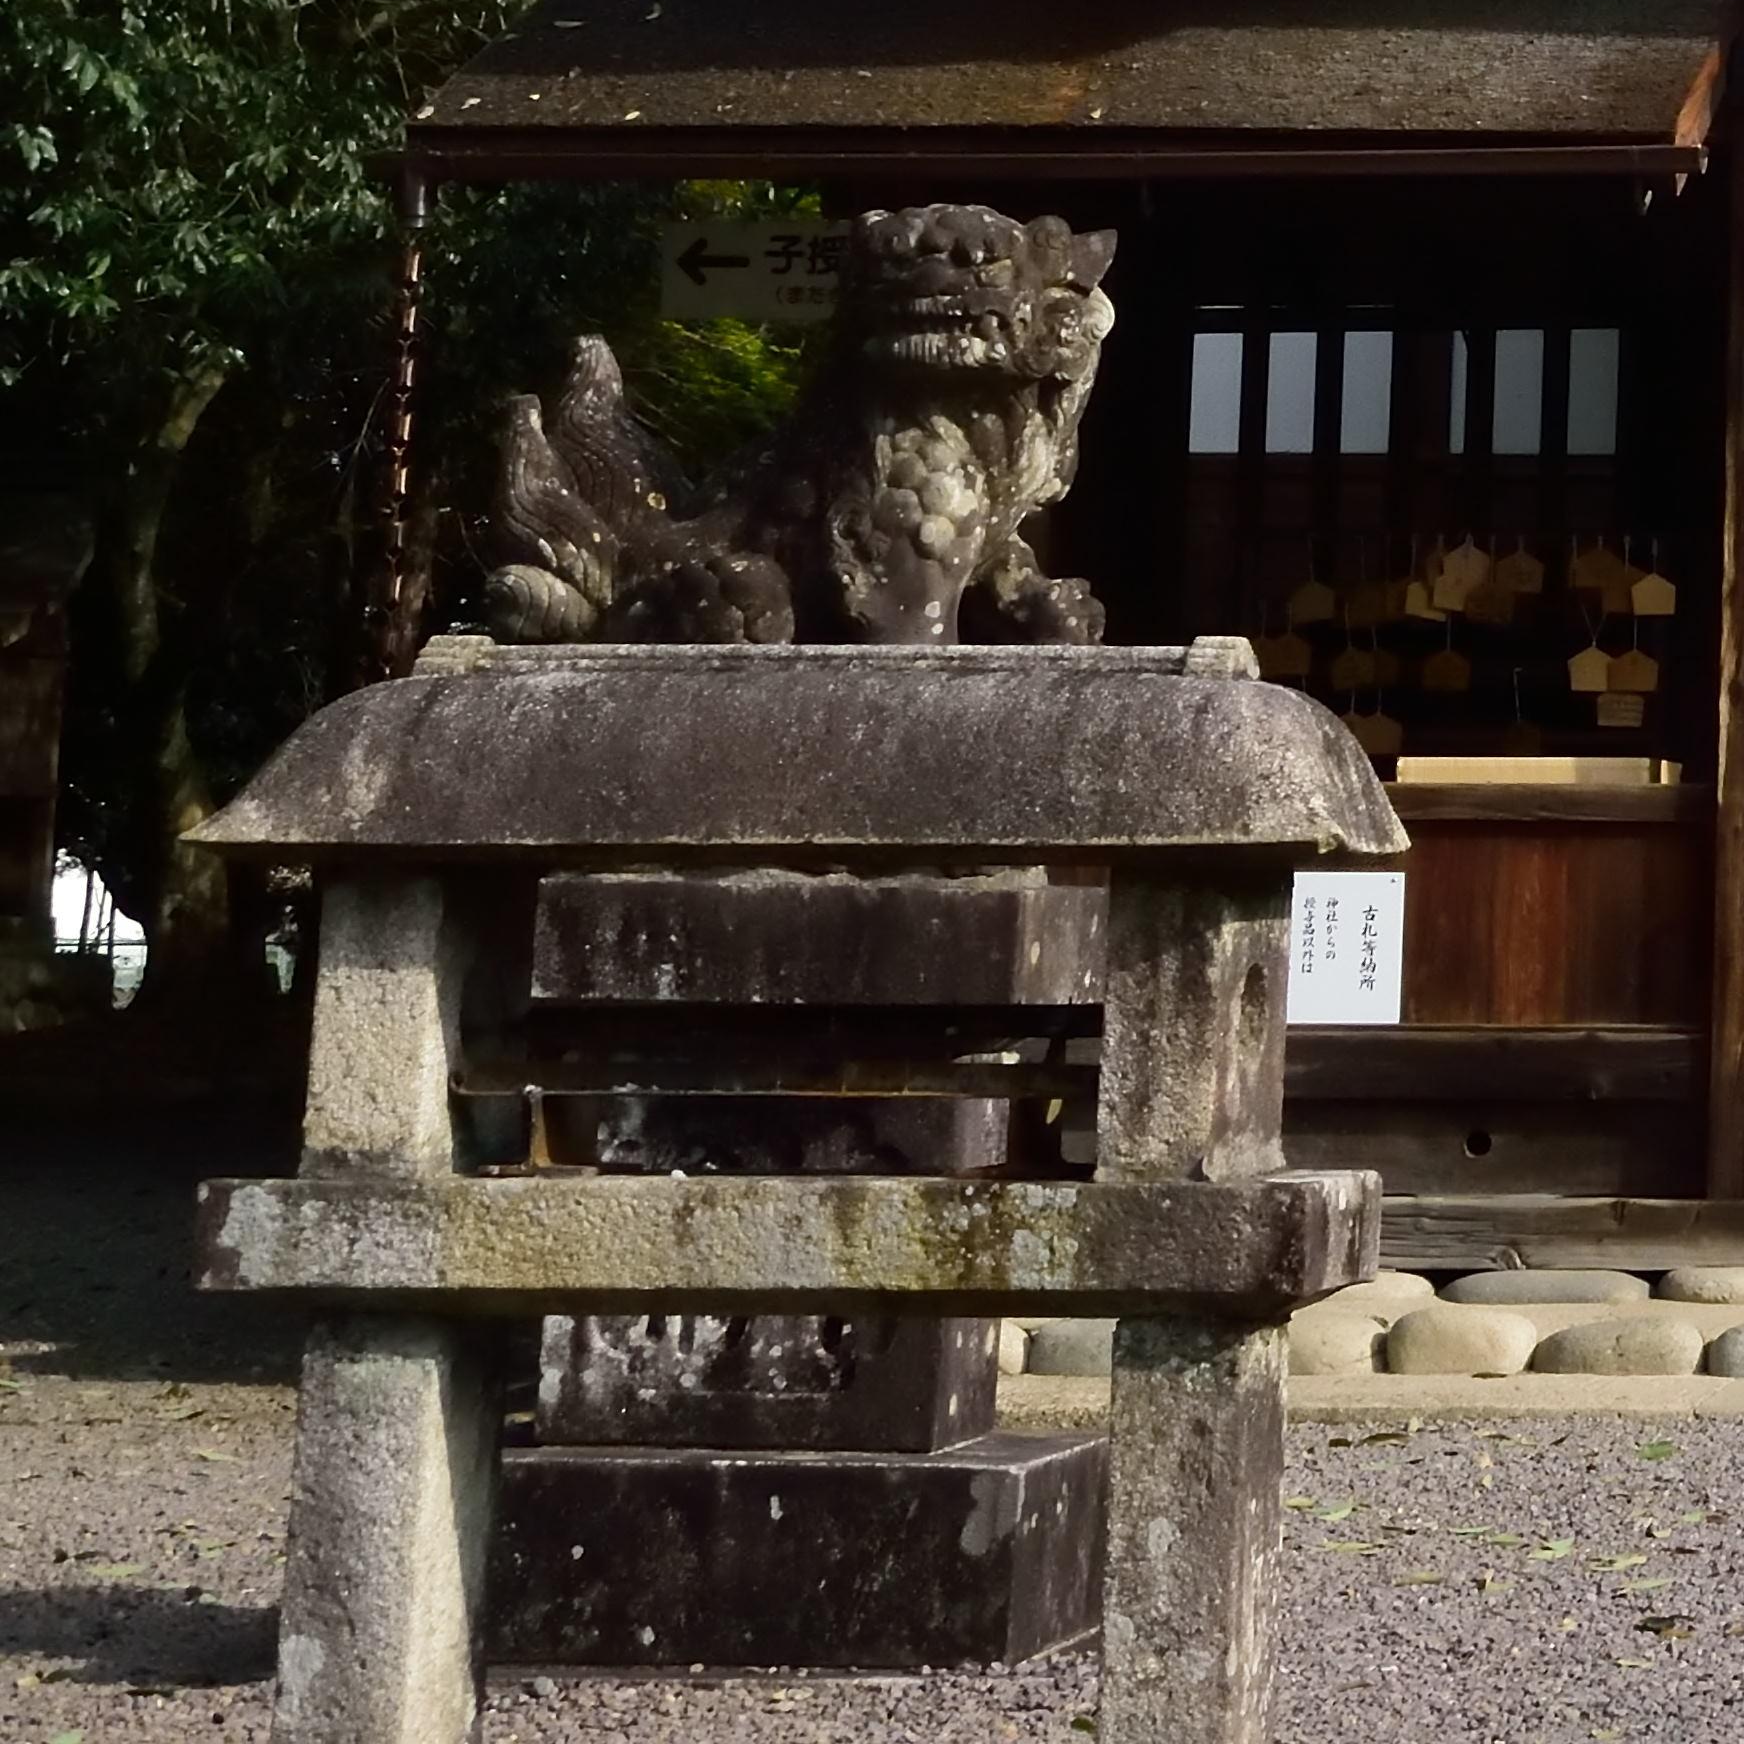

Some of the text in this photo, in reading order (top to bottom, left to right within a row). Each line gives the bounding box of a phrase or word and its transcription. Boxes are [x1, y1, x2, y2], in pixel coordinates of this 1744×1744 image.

[1301, 897, 1317, 974] 授与品以外は
[1326, 897, 1339, 960] 神社からの
[1359, 904, 1379, 992] 古札等納所
